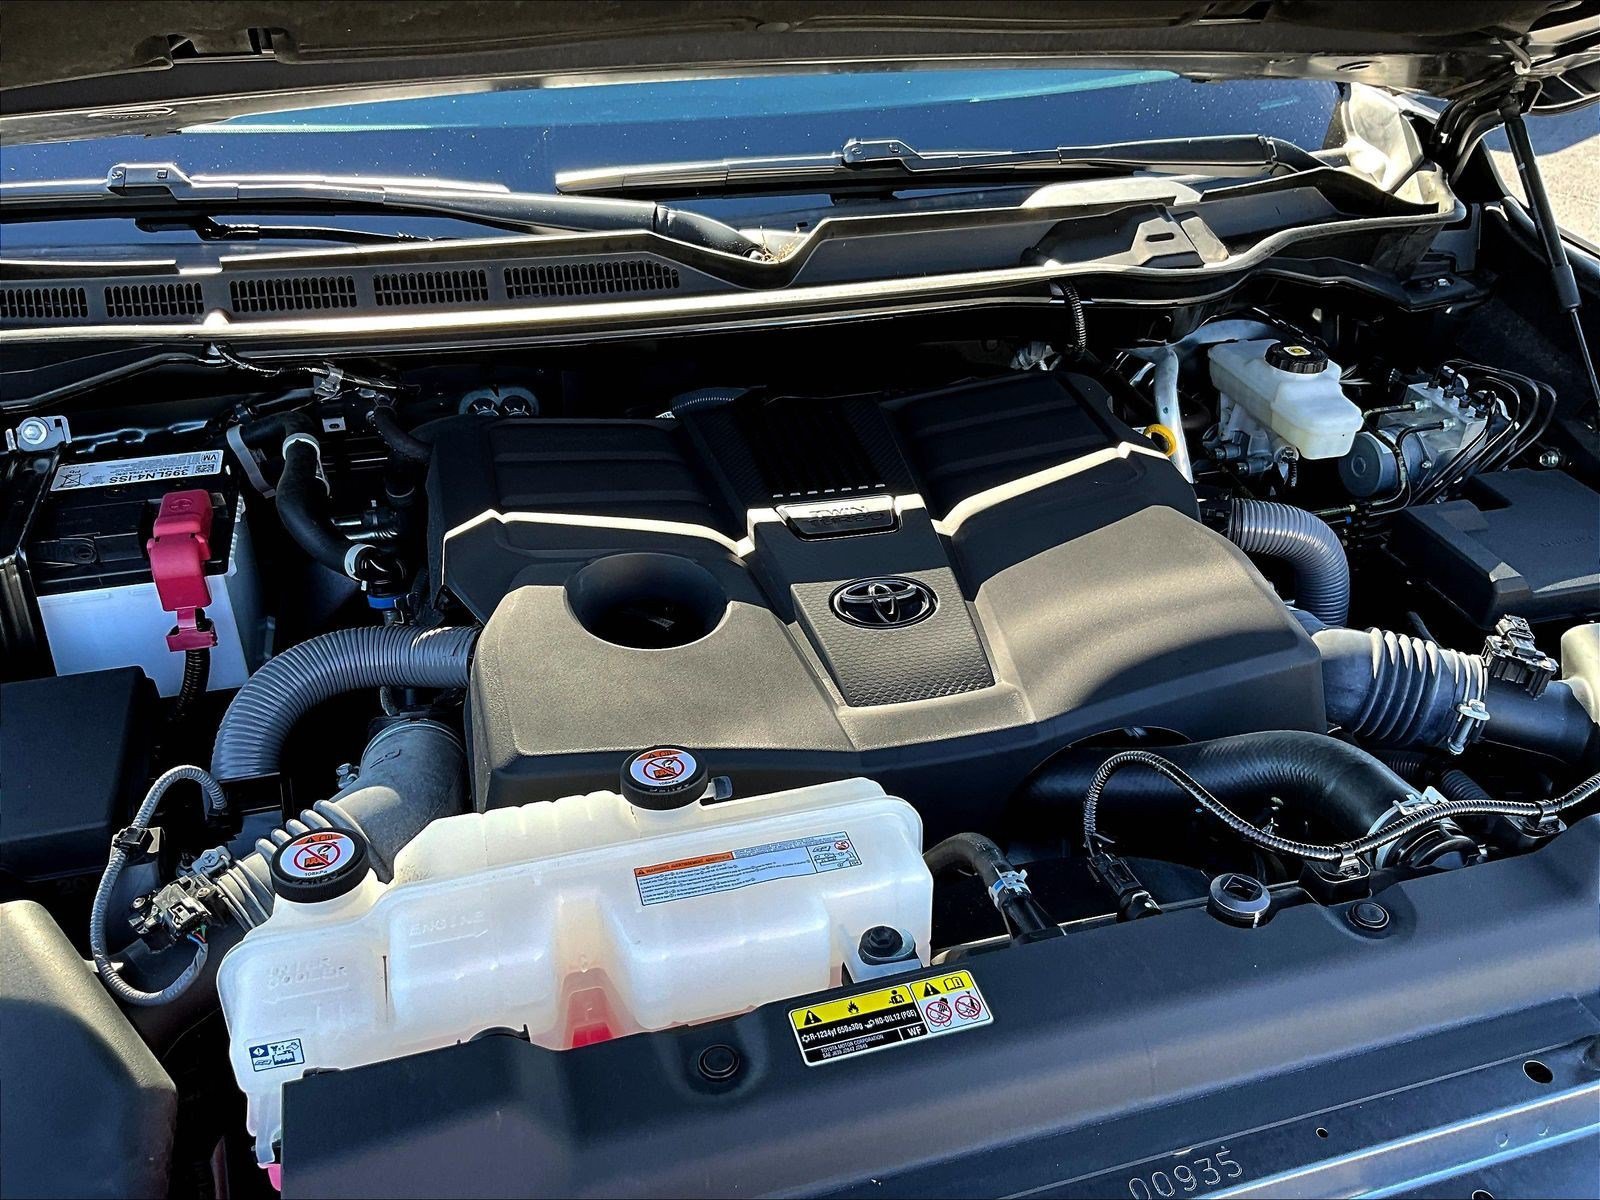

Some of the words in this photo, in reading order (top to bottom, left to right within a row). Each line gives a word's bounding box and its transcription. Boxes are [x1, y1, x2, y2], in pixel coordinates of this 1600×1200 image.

[109, 469, 189, 483] 395LN4-ISS
[809, 506, 865, 518] TWIN
[907, 1026, 921, 1036] WF
[820, 1045, 837, 1054] TOYOTA
[838, 1041, 854, 1049] MOTOR
[854, 1034, 884, 1046] CORPORATION
[1128, 1150, 1243, 1200] 00935
